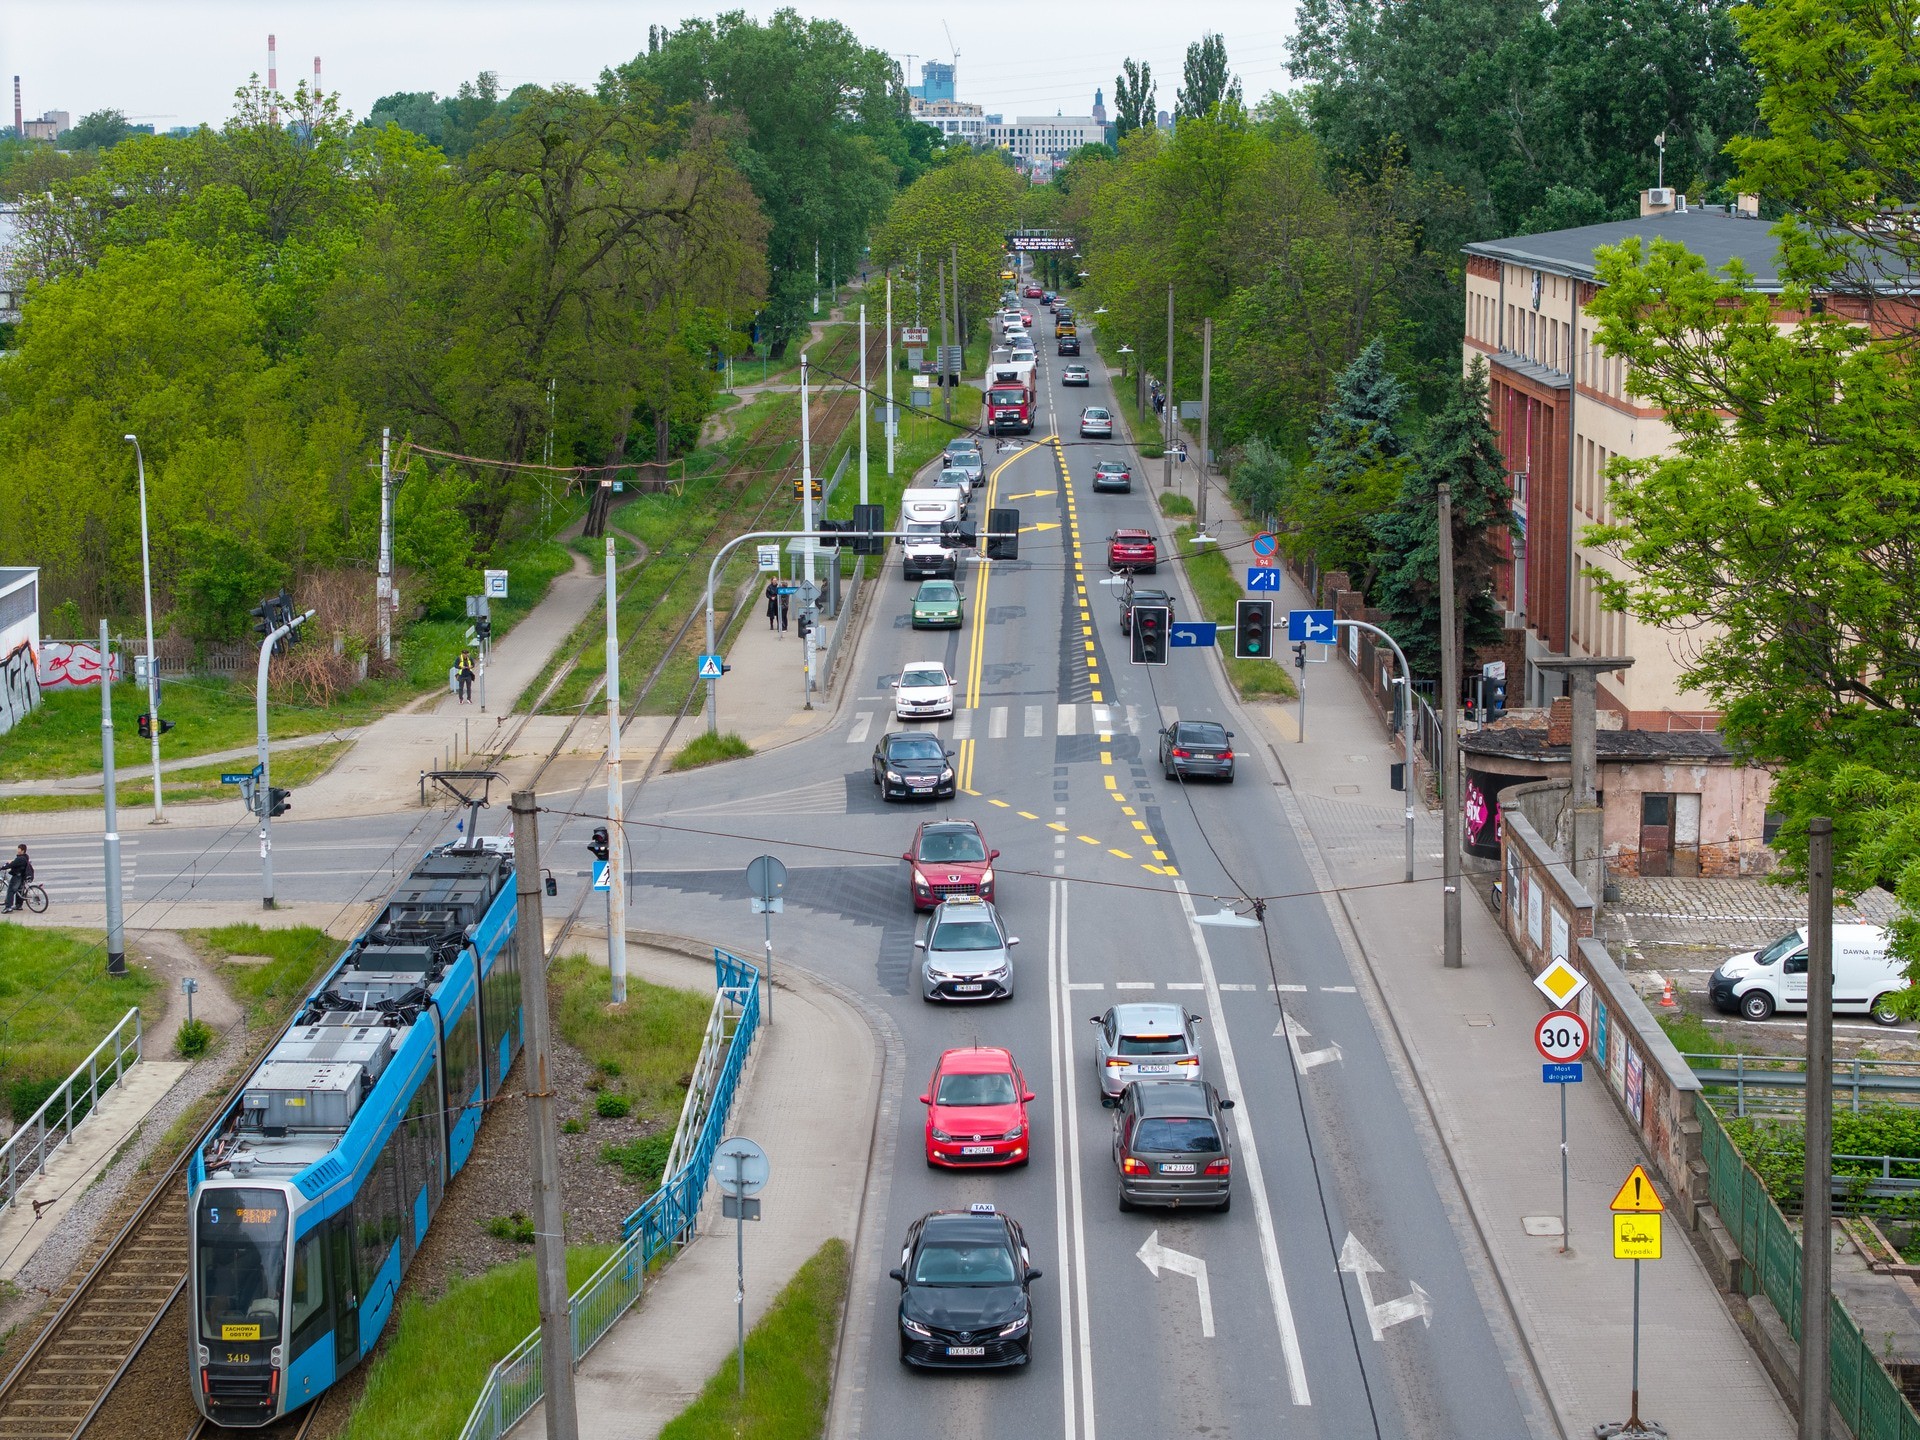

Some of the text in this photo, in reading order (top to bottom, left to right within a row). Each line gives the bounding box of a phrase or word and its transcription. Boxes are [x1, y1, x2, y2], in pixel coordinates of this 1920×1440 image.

[1542, 1029, 1581, 1048] 30 t
[210, 1207, 219, 1224] 5
[1623, 1248, 1653, 1256] Wypadki
[227, 1353, 250, 1364] 3419
